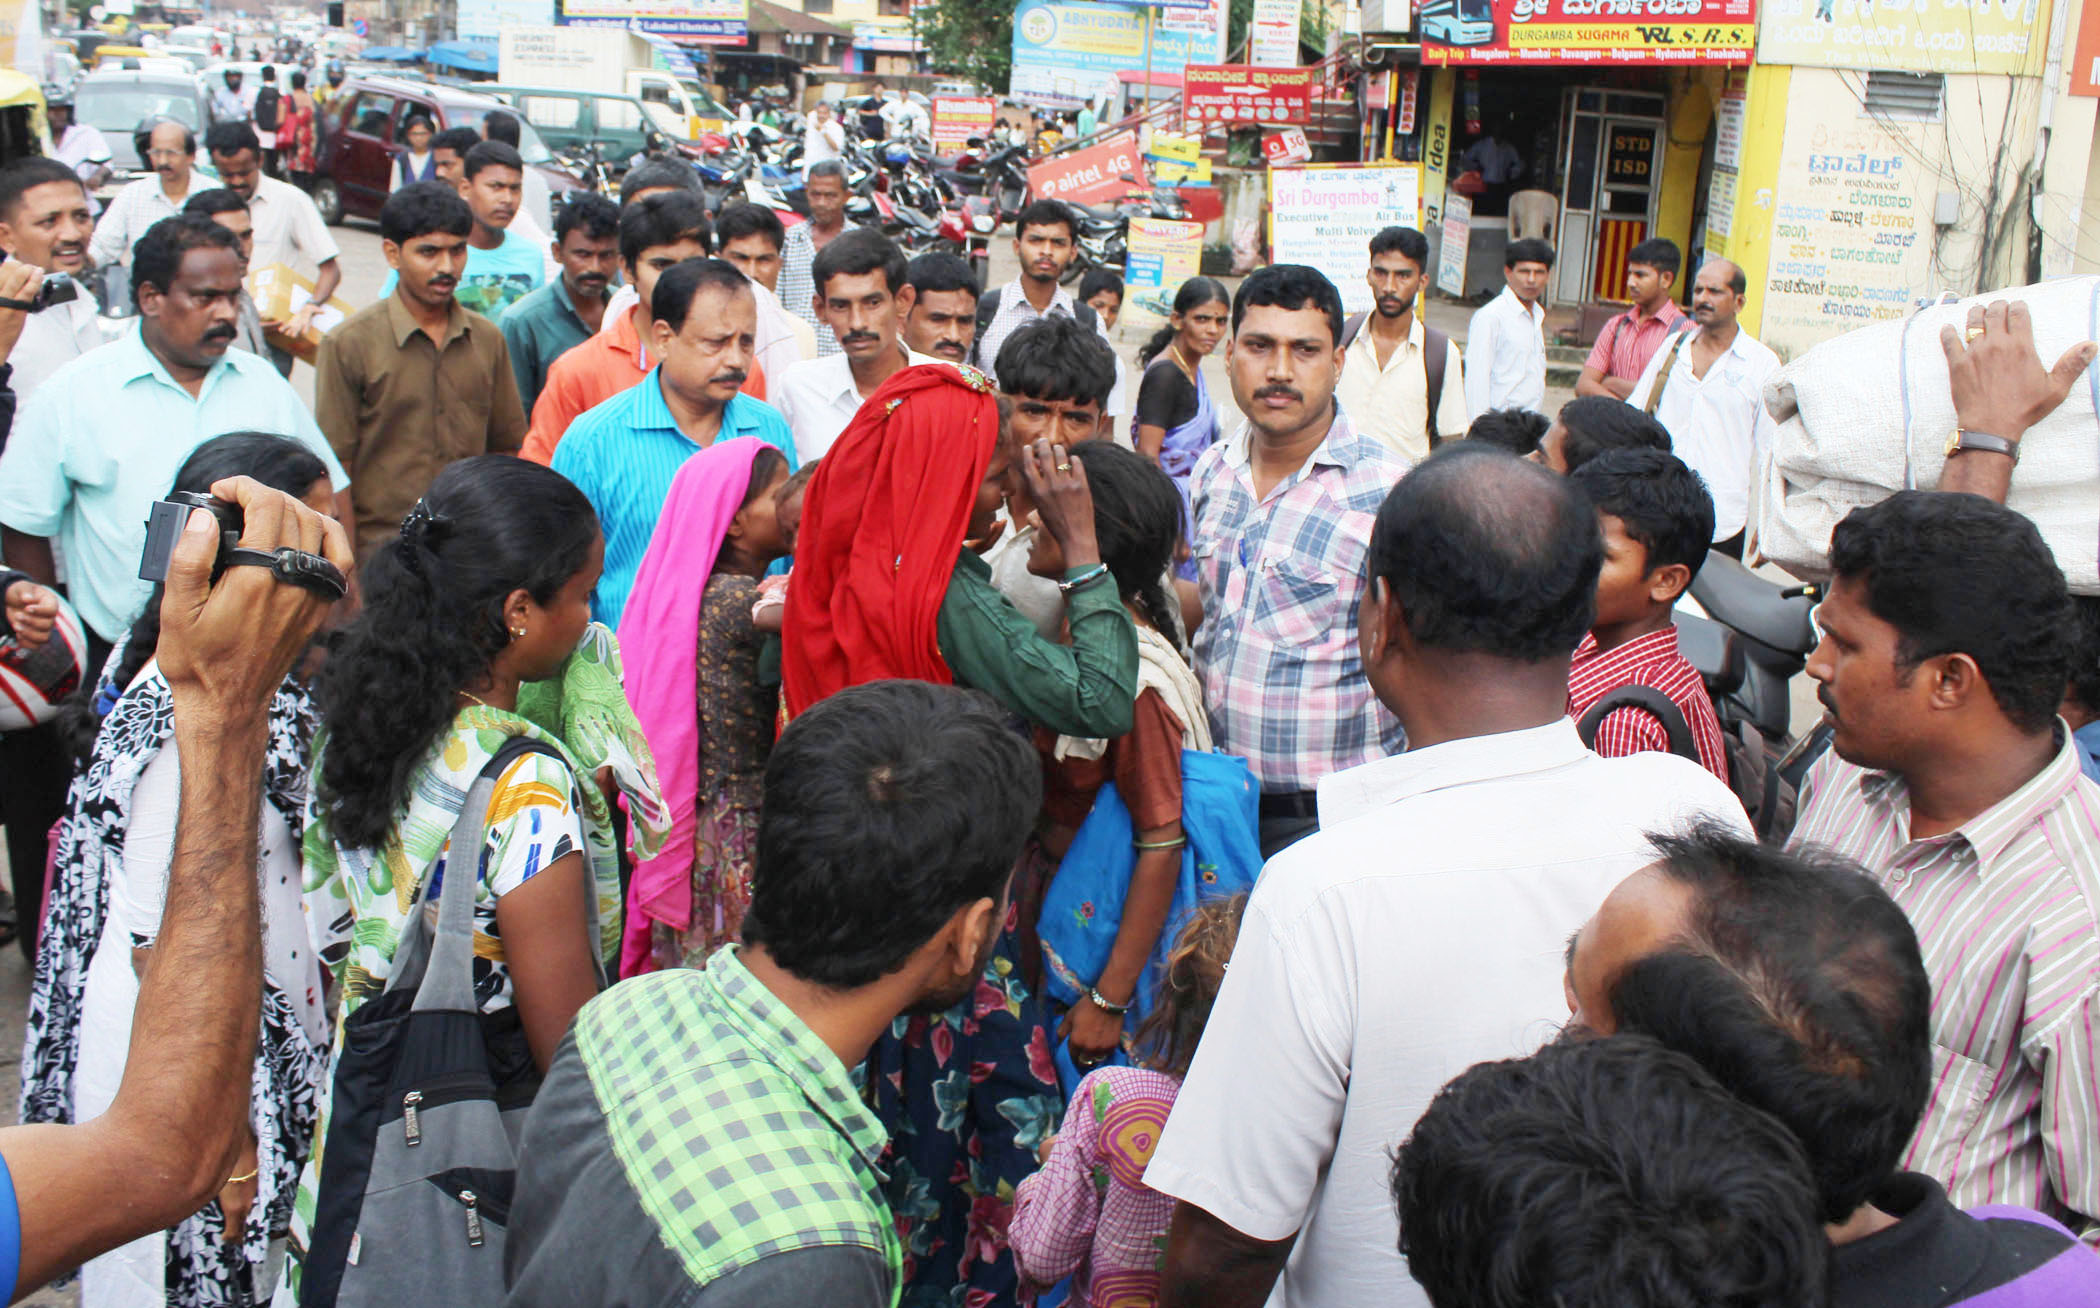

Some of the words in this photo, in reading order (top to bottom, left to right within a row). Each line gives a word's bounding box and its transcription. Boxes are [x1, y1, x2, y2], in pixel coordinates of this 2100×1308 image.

[1063, 11, 1141, 31] ABHYUDAYA
[1511, 29, 1573, 41] DURGAMBA
[1577, 29, 1630, 42] SUGAMA
[1428, 48, 1448, 60] Daily
[1450, 48, 1465, 60] Trip
[1470, 48, 1510, 60] Bangalore
[1520, 48, 1551, 59] Mumbai
[1655, 48, 1697, 60] Hyderabad
[1289, 135, 1305, 149] 3G
[1615, 135, 1651, 152] STD
[1057, 164, 1102, 193] airtel
[1106, 154, 1132, 175] 4G
[1613, 159, 1649, 175] ISD
[1277, 188, 1297, 207] Sri
[1302, 188, 1380, 210] Durgamba
[1276, 212, 1330, 223] Executive
[1375, 211, 1391, 222] Air
[1315, 227, 1343, 237] Multi
[1346, 227, 1377, 237] Volvo
